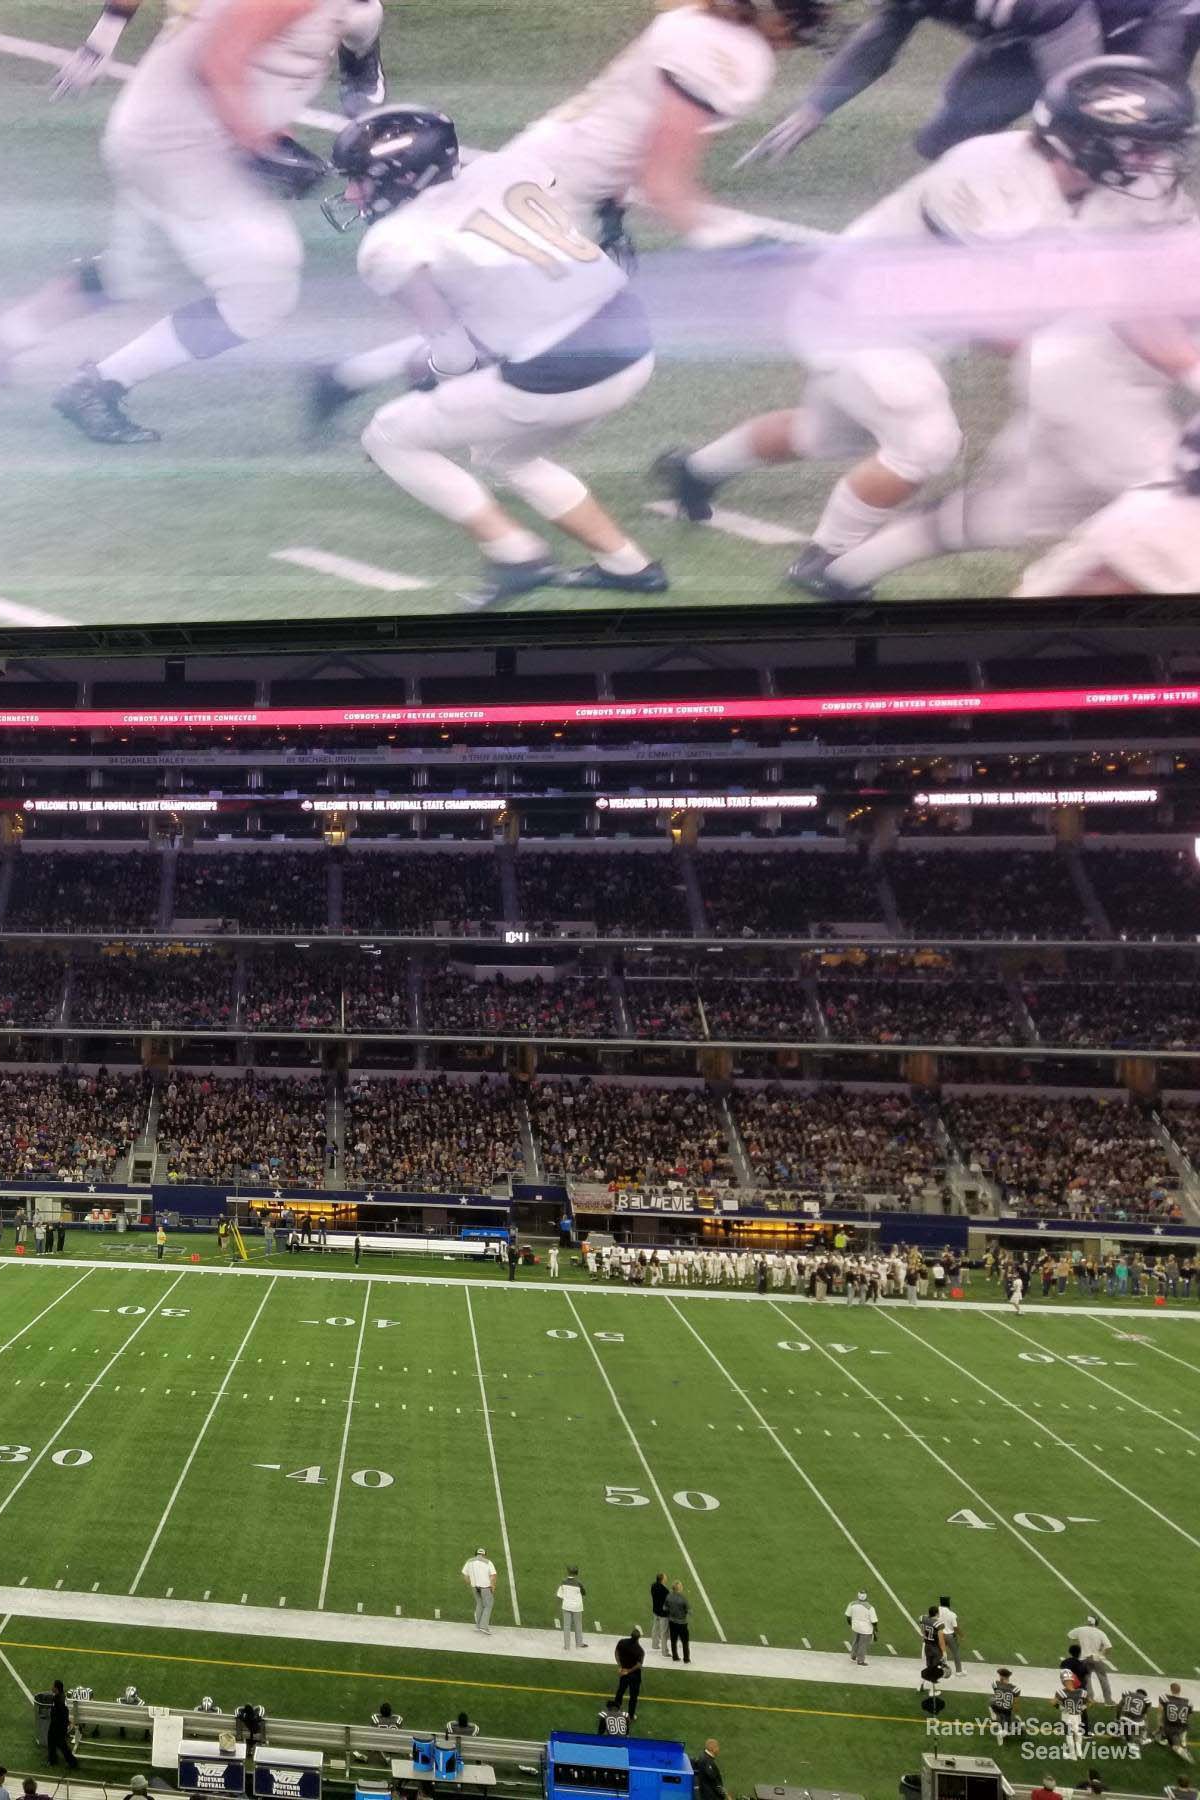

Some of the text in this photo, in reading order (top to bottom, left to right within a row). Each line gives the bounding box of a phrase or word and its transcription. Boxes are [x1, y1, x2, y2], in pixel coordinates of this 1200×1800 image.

[1123, 1697, 1143, 1715] 13
[1166, 1704, 1188, 1723] 64
[606, 1716, 627, 1735] 86
